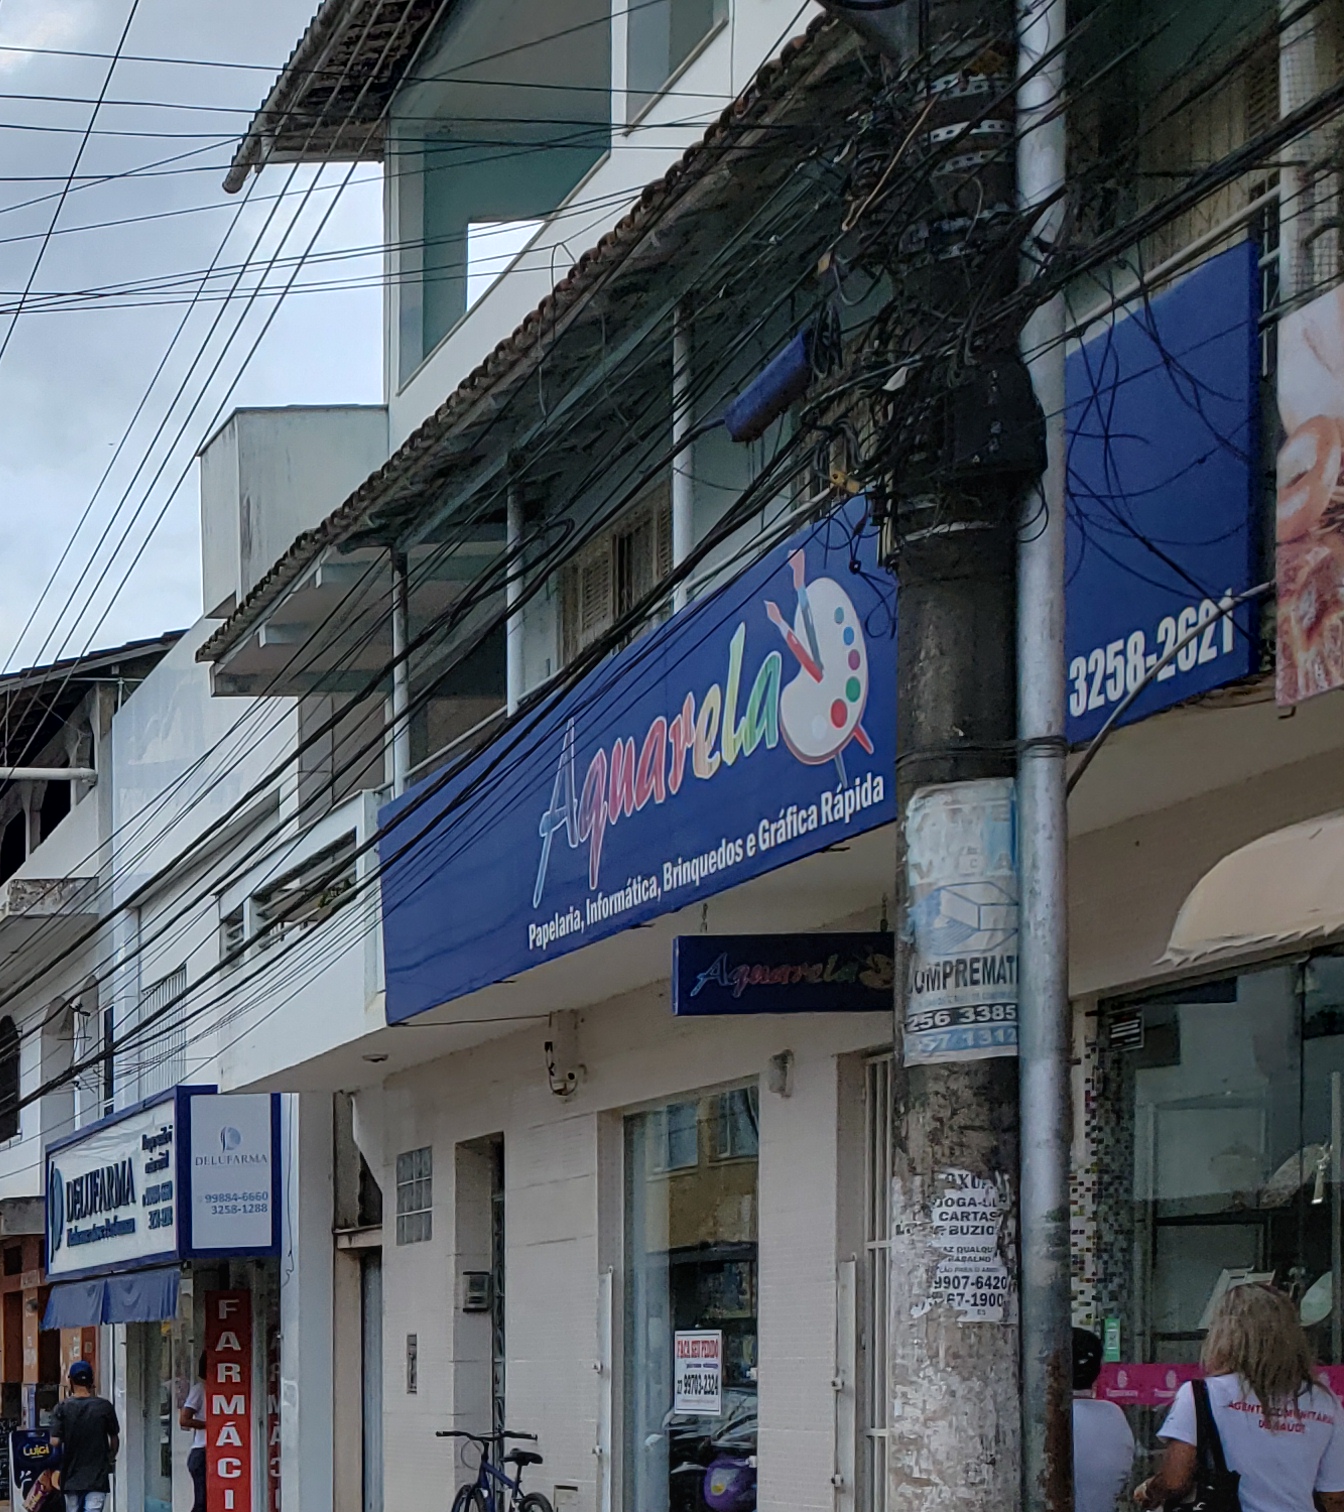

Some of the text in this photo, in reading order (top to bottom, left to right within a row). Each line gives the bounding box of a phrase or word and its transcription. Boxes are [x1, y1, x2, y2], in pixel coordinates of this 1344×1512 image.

[1068, 588, 1235, 718] 3258-2621
[532, 622, 783, 909] Aquarela
[528, 772, 885, 950] Papelaria, Informática, Brinquedos e Gráfica Rápida
[195, 1153, 269, 1167] DELUFARMA
[66, 1157, 137, 1223] DELUFARMA
[211, 1204, 268, 1215] 3258-1288
[938, 1211, 1000, 1222] CARTAS
[1228, 1400, 1263, 1415] AGENT
